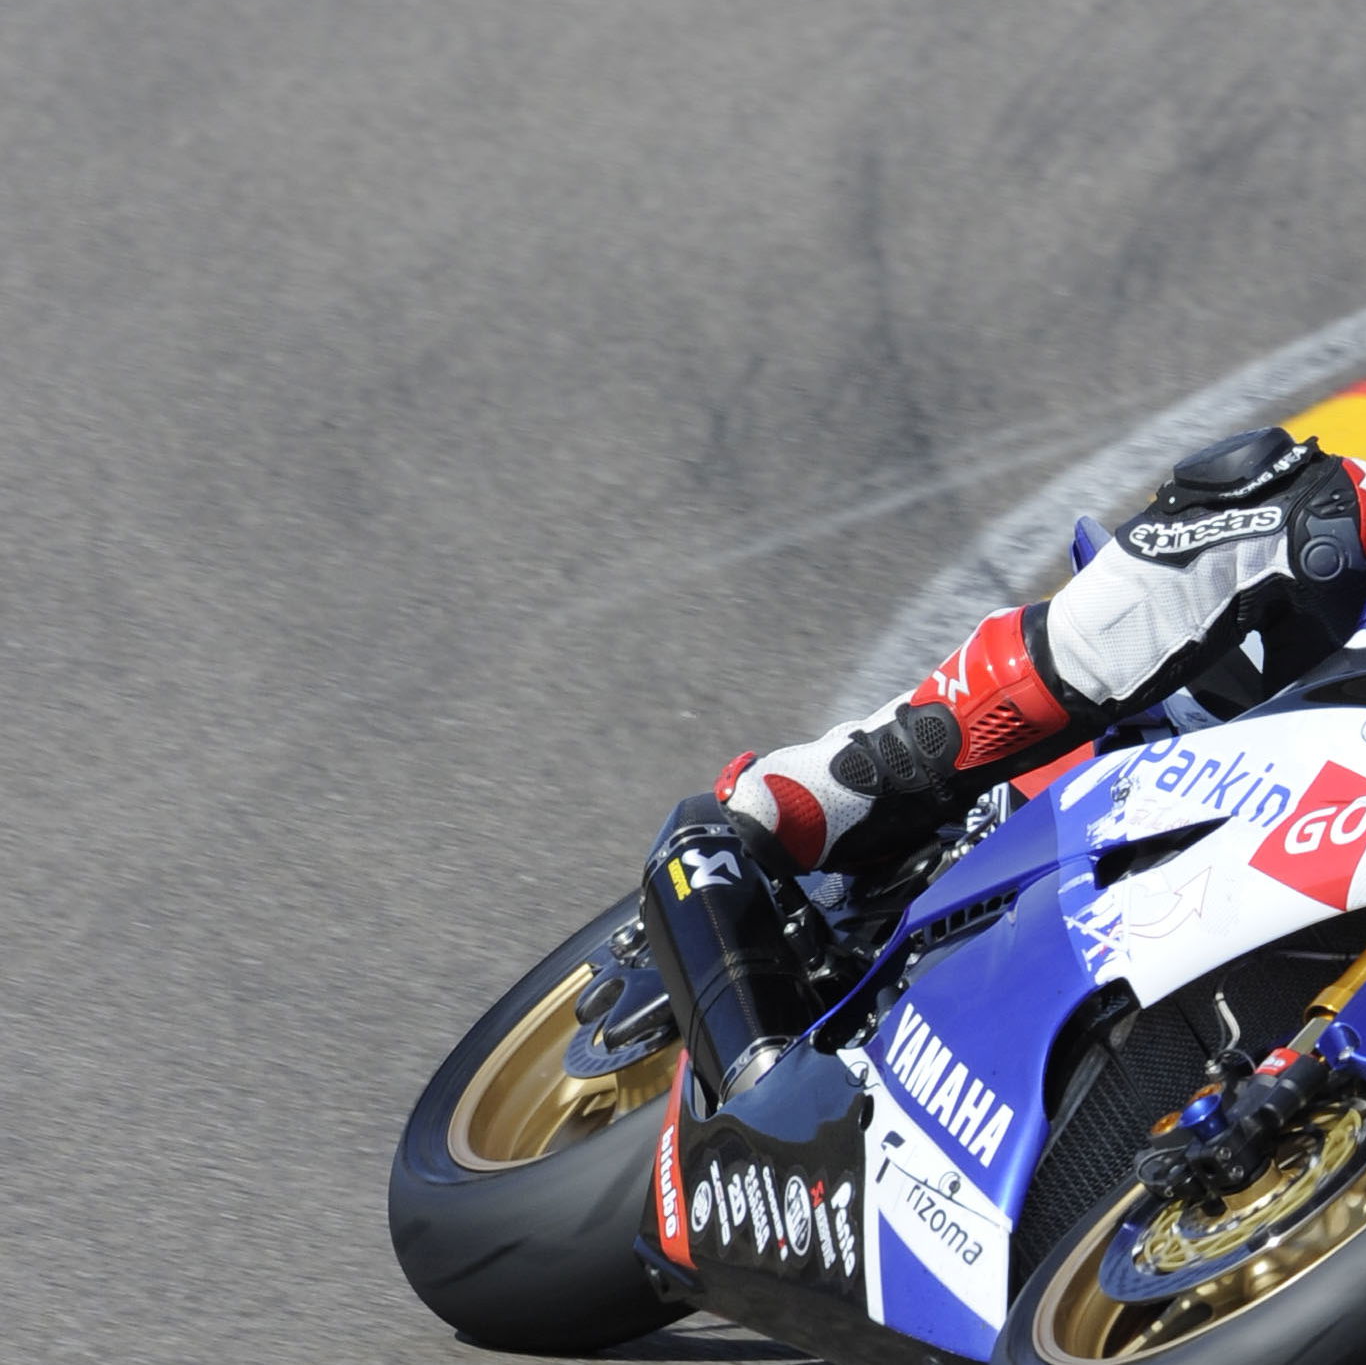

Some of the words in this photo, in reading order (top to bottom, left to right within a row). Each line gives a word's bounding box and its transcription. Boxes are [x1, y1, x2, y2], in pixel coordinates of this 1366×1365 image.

[1124, 736, 1291, 828] Parkin
[885, 1002, 1015, 1169] YAMAHA
[660, 1124, 678, 1239] bitubo
[727, 1173, 748, 1227] 2D
[906, 1183, 984, 1266] rizoma
